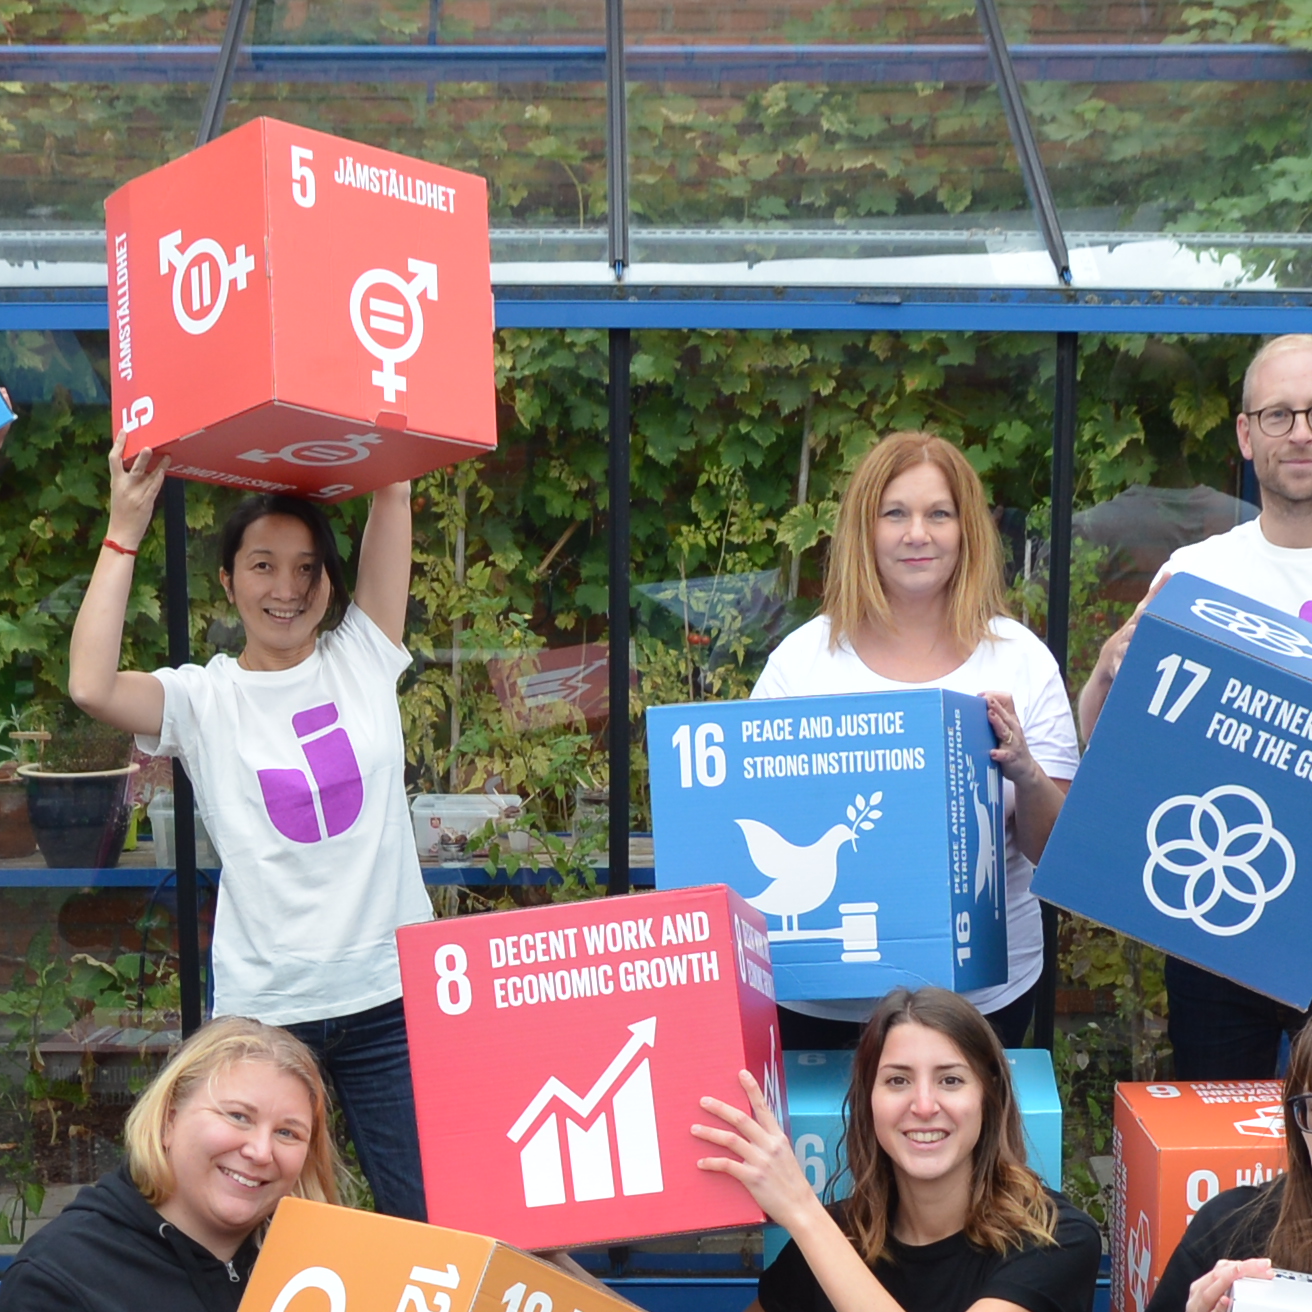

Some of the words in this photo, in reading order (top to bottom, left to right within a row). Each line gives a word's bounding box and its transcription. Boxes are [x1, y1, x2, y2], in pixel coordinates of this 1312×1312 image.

[291, 145, 316, 208] 5
[334, 157, 456, 214] JÄMSTÄLLDHET
[115, 231, 133, 381] JÄMSTÄLLDHET
[122, 395, 155, 434] 5
[1146, 653, 1212, 724] 17
[671, 721, 728, 789] 16
[741, 718, 795, 743] PEACE
[798, 715, 833, 740] AND
[835, 711, 905, 737] JUSTICE
[743, 754, 810, 780] STRONG
[811, 746, 926, 776] INSTITUTIONS
[947, 725, 958, 802] JUSTICE
[954, 708, 967, 822] INSTITUTIONS
[1205, 711, 1251, 755] FOR
[1253, 728, 1298, 773] THE
[951, 806, 959, 836] AND
[954, 840, 962, 895] PEACE
[961, 827, 969, 894] STRONG
[433, 942, 473, 1016] 8
[488, 926, 579, 969] DECENT
[581, 917, 655, 955] WORK
[660, 910, 710, 945] AND
[955, 910, 972, 967] 16
[492, 964, 615, 1010] ECONOMIC
[618, 949, 720, 992] GROWTH
[1145, 1084, 1182, 1099] 9
[1195, 1088, 1284, 1098] INNOVATI
[1201, 1094, 1283, 1105] INFRAST
